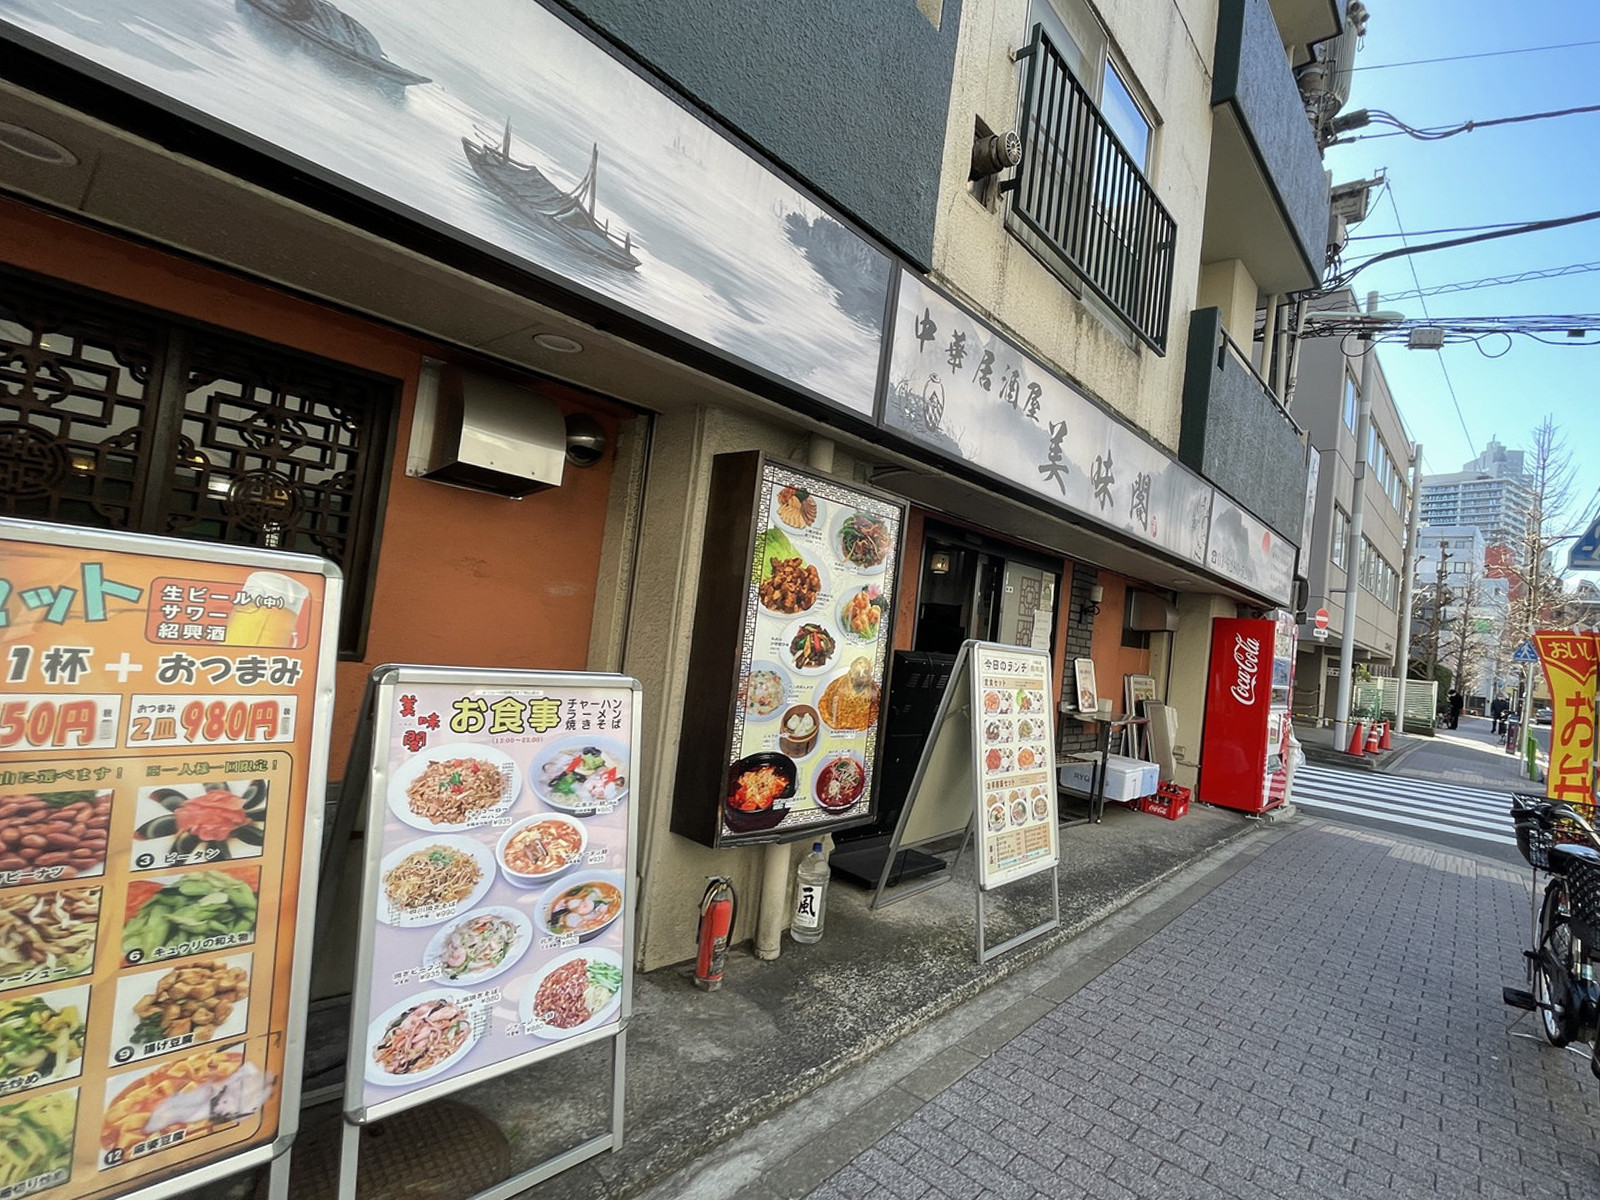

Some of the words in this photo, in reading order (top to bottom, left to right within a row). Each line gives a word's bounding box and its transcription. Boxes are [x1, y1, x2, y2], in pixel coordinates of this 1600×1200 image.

[914, 306, 1042, 422] 中華居酒屋
[0, 562, 144, 628] ット
[161, 603, 228, 620] サワー
[157, 622, 227, 641] 紹興酒
[156, 652, 303, 687] おつまみ
[1230, 632, 1260, 705] Coca-Cola
[136, 703, 176, 714] おつまみ
[567, 698, 622, 709] チャーハン
[180, 700, 279, 743] 980円
[449, 696, 562, 734] お食事
[567, 708, 622, 719] ラーメン
[565, 719, 622, 730] 焼きそば
[165, 848, 220, 864] ピータン
